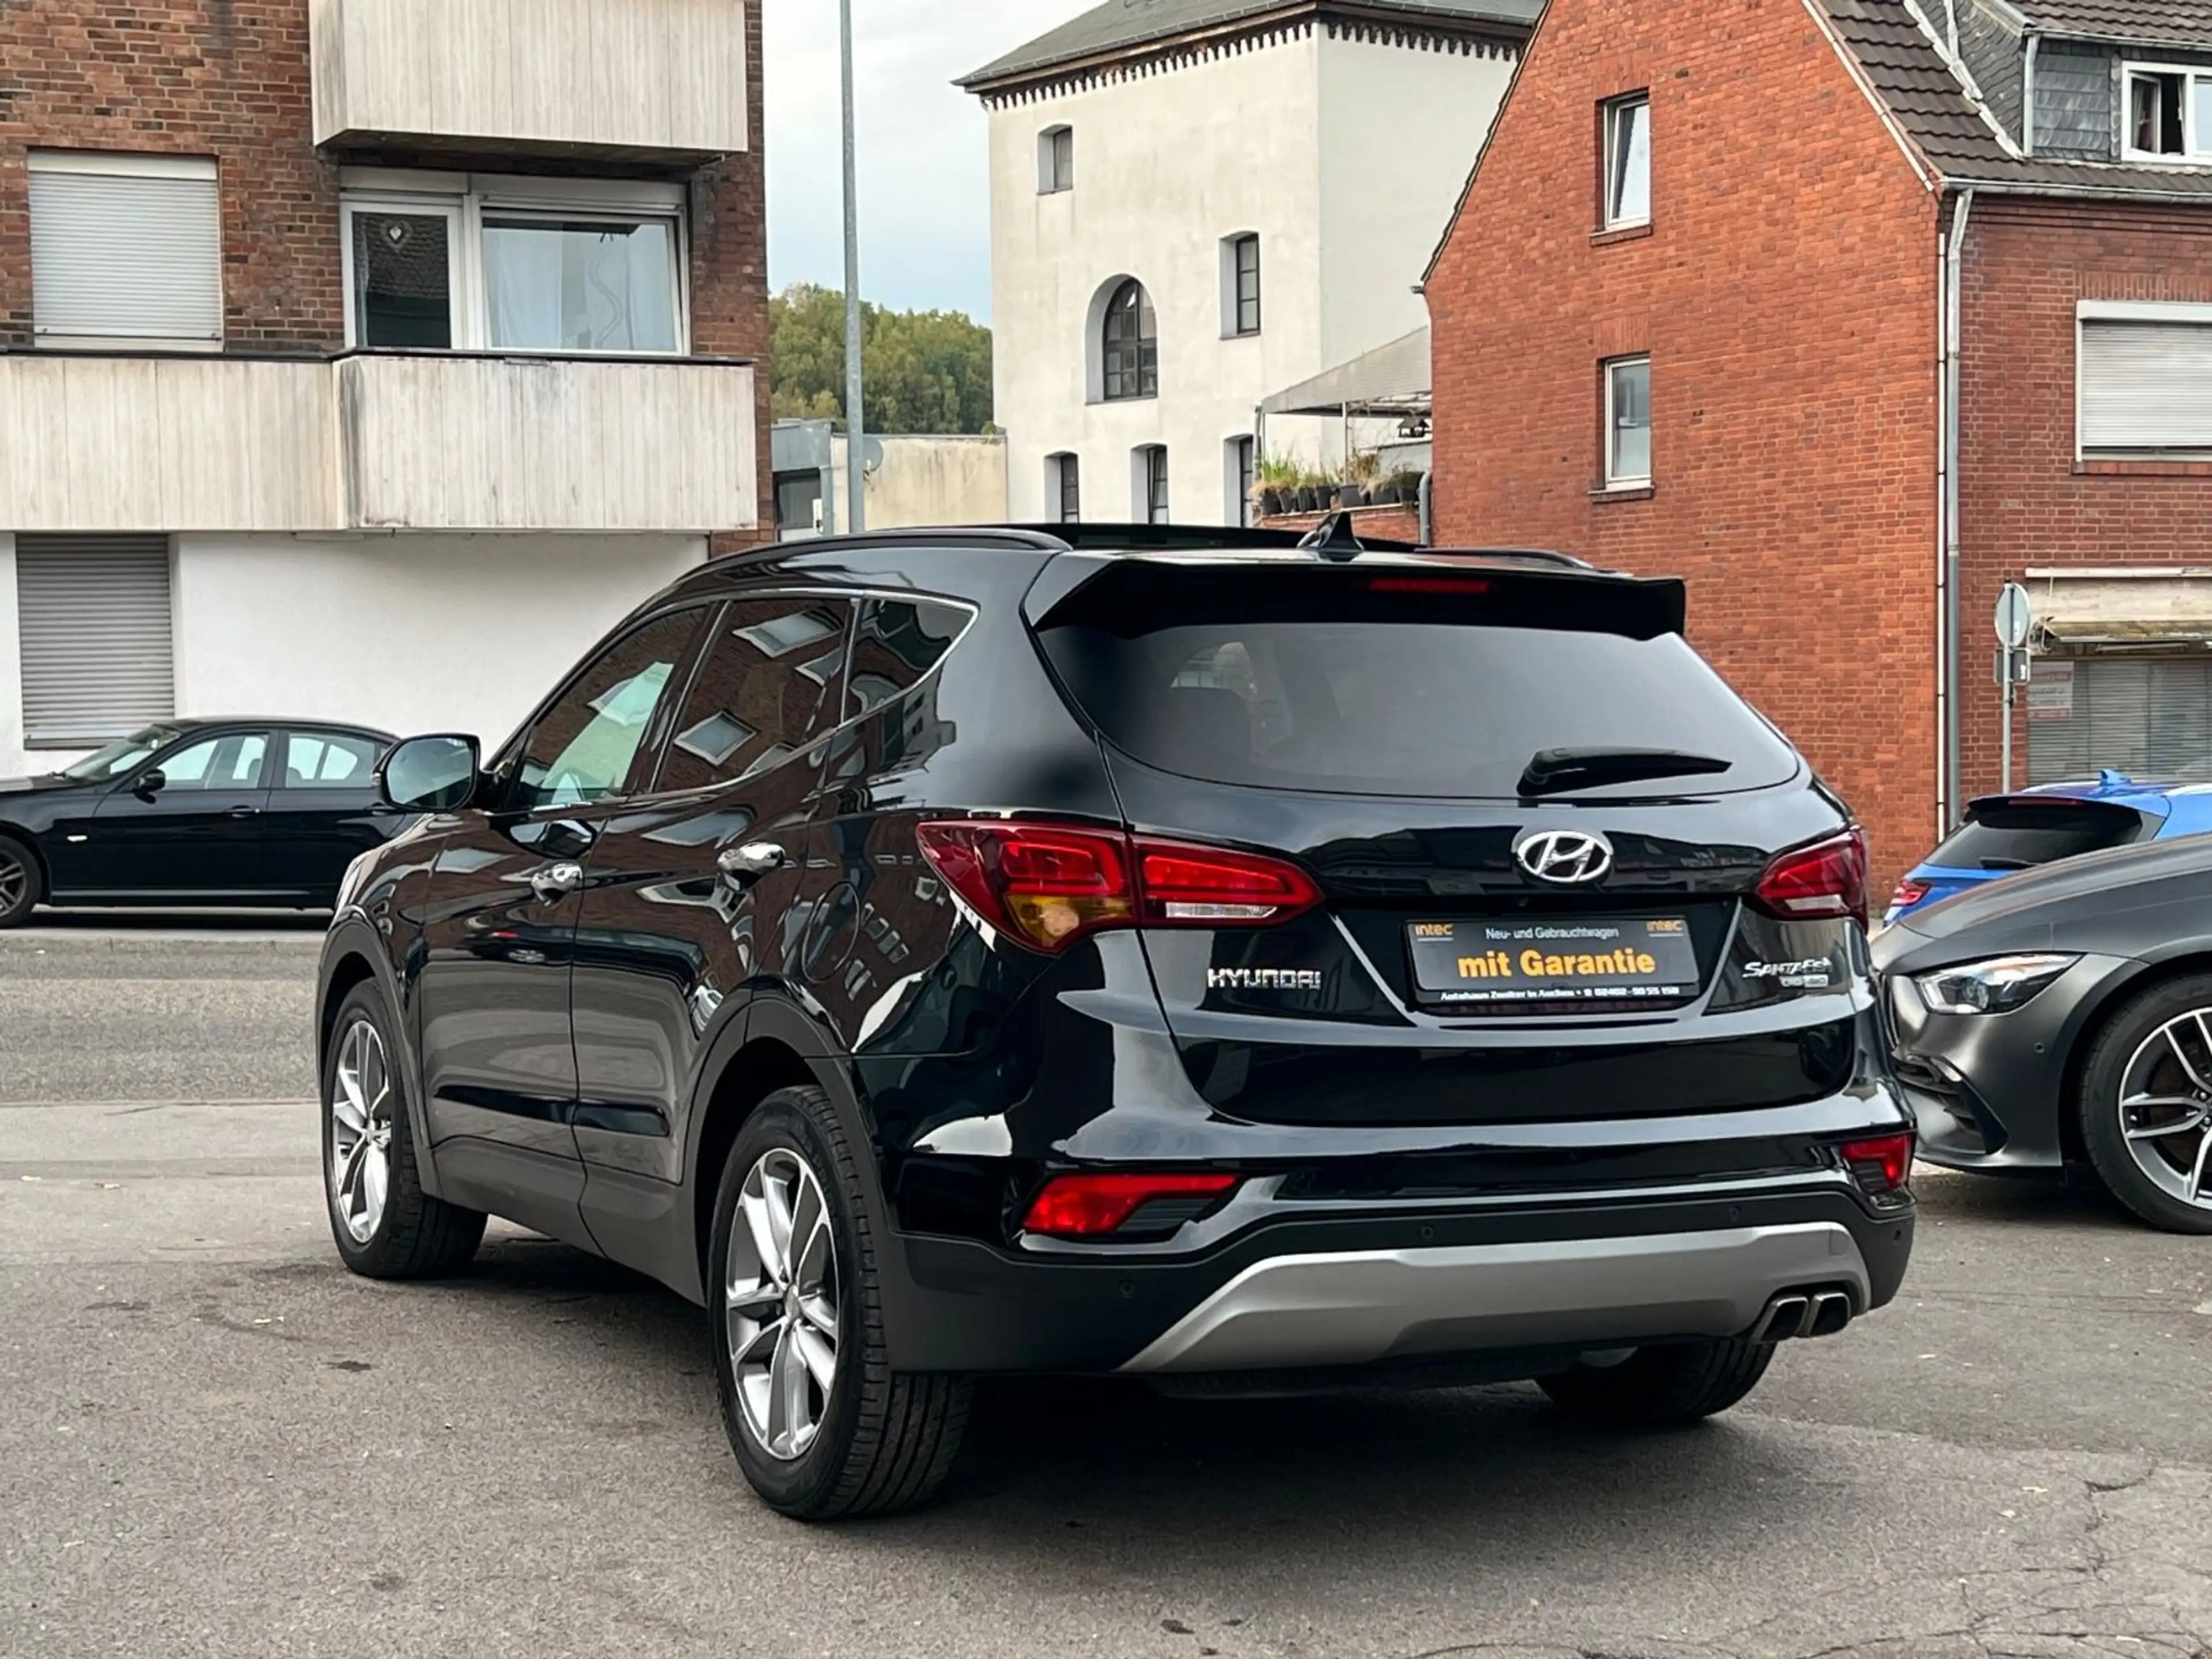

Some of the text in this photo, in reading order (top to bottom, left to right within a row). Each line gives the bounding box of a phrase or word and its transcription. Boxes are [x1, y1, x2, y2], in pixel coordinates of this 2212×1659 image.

[1486, 926, 1620, 940] Neu- und Gebrauchtwagen
[1458, 948, 1656, 978] mit Garantie
[1207, 968, 1321, 989] HYUNDAI
